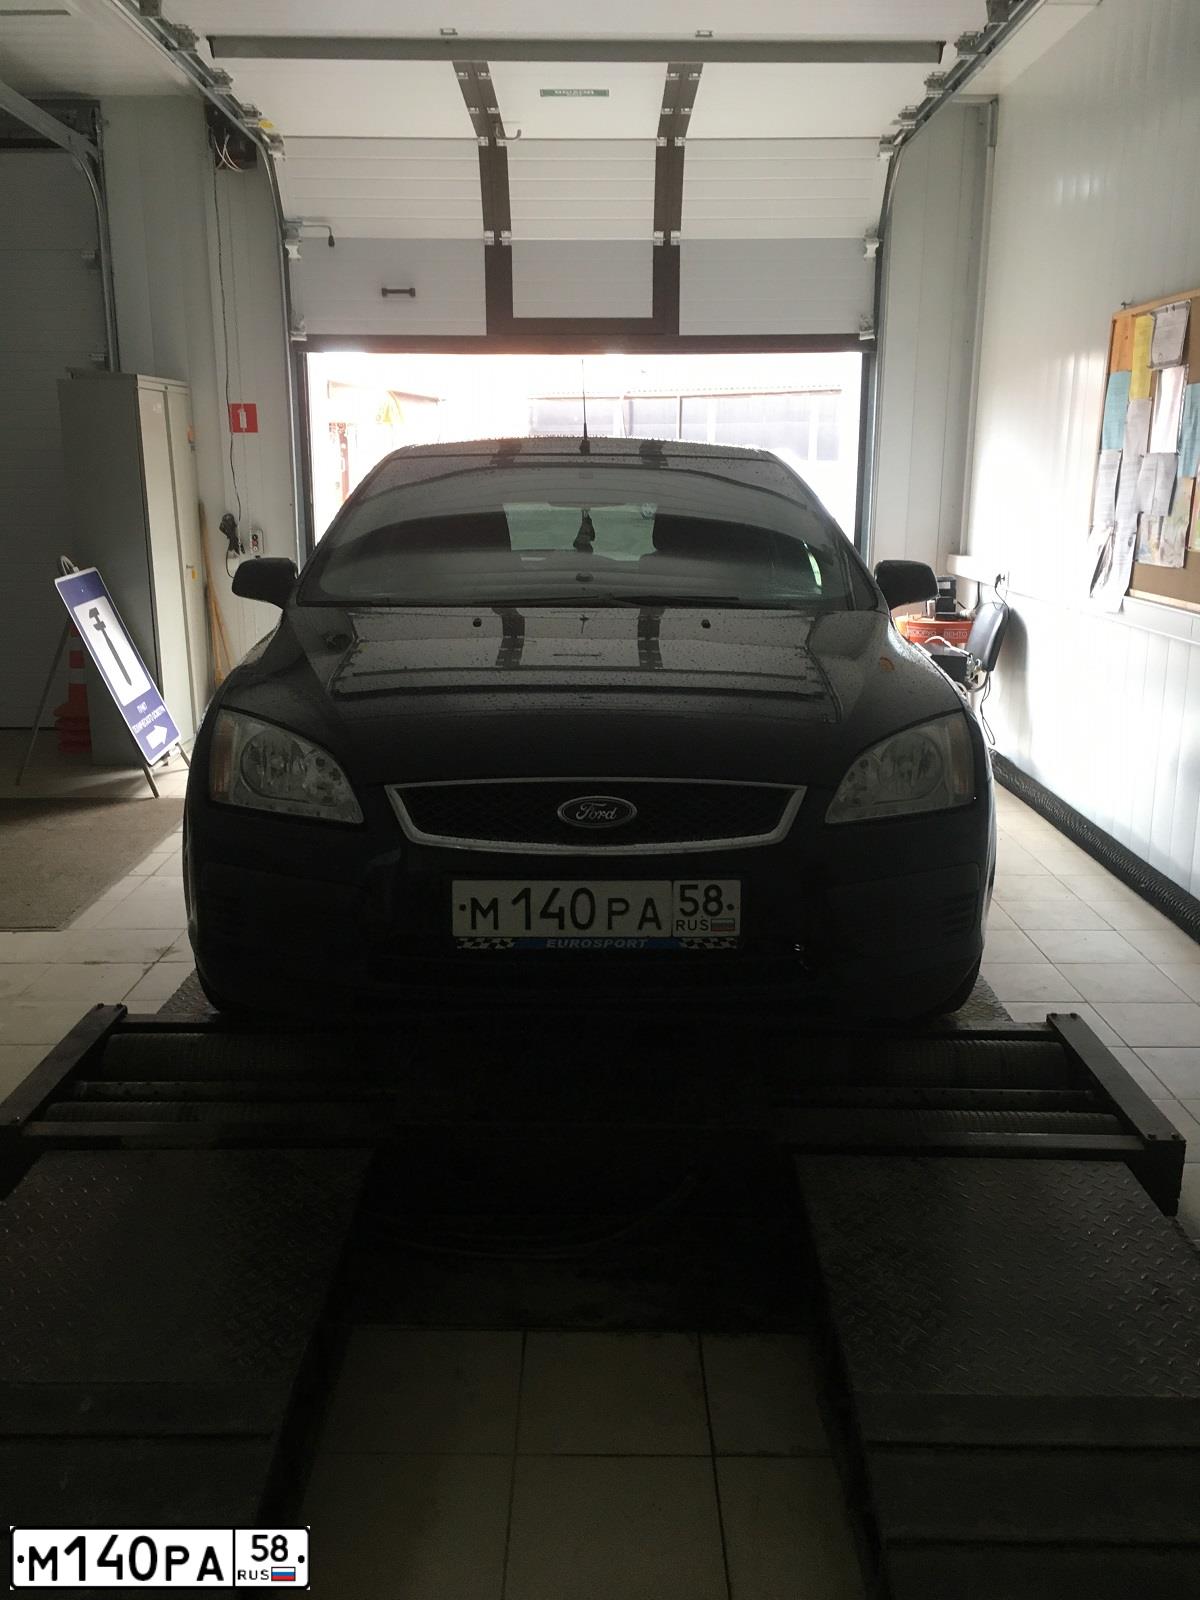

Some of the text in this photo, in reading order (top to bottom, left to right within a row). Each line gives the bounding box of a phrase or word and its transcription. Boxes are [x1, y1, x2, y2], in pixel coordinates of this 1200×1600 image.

[576, 802, 618, 820] Ford
[679, 884, 723, 917] 58
[676, 919, 709, 932] RUS
[546, 938, 649, 949] EUROSPORT
